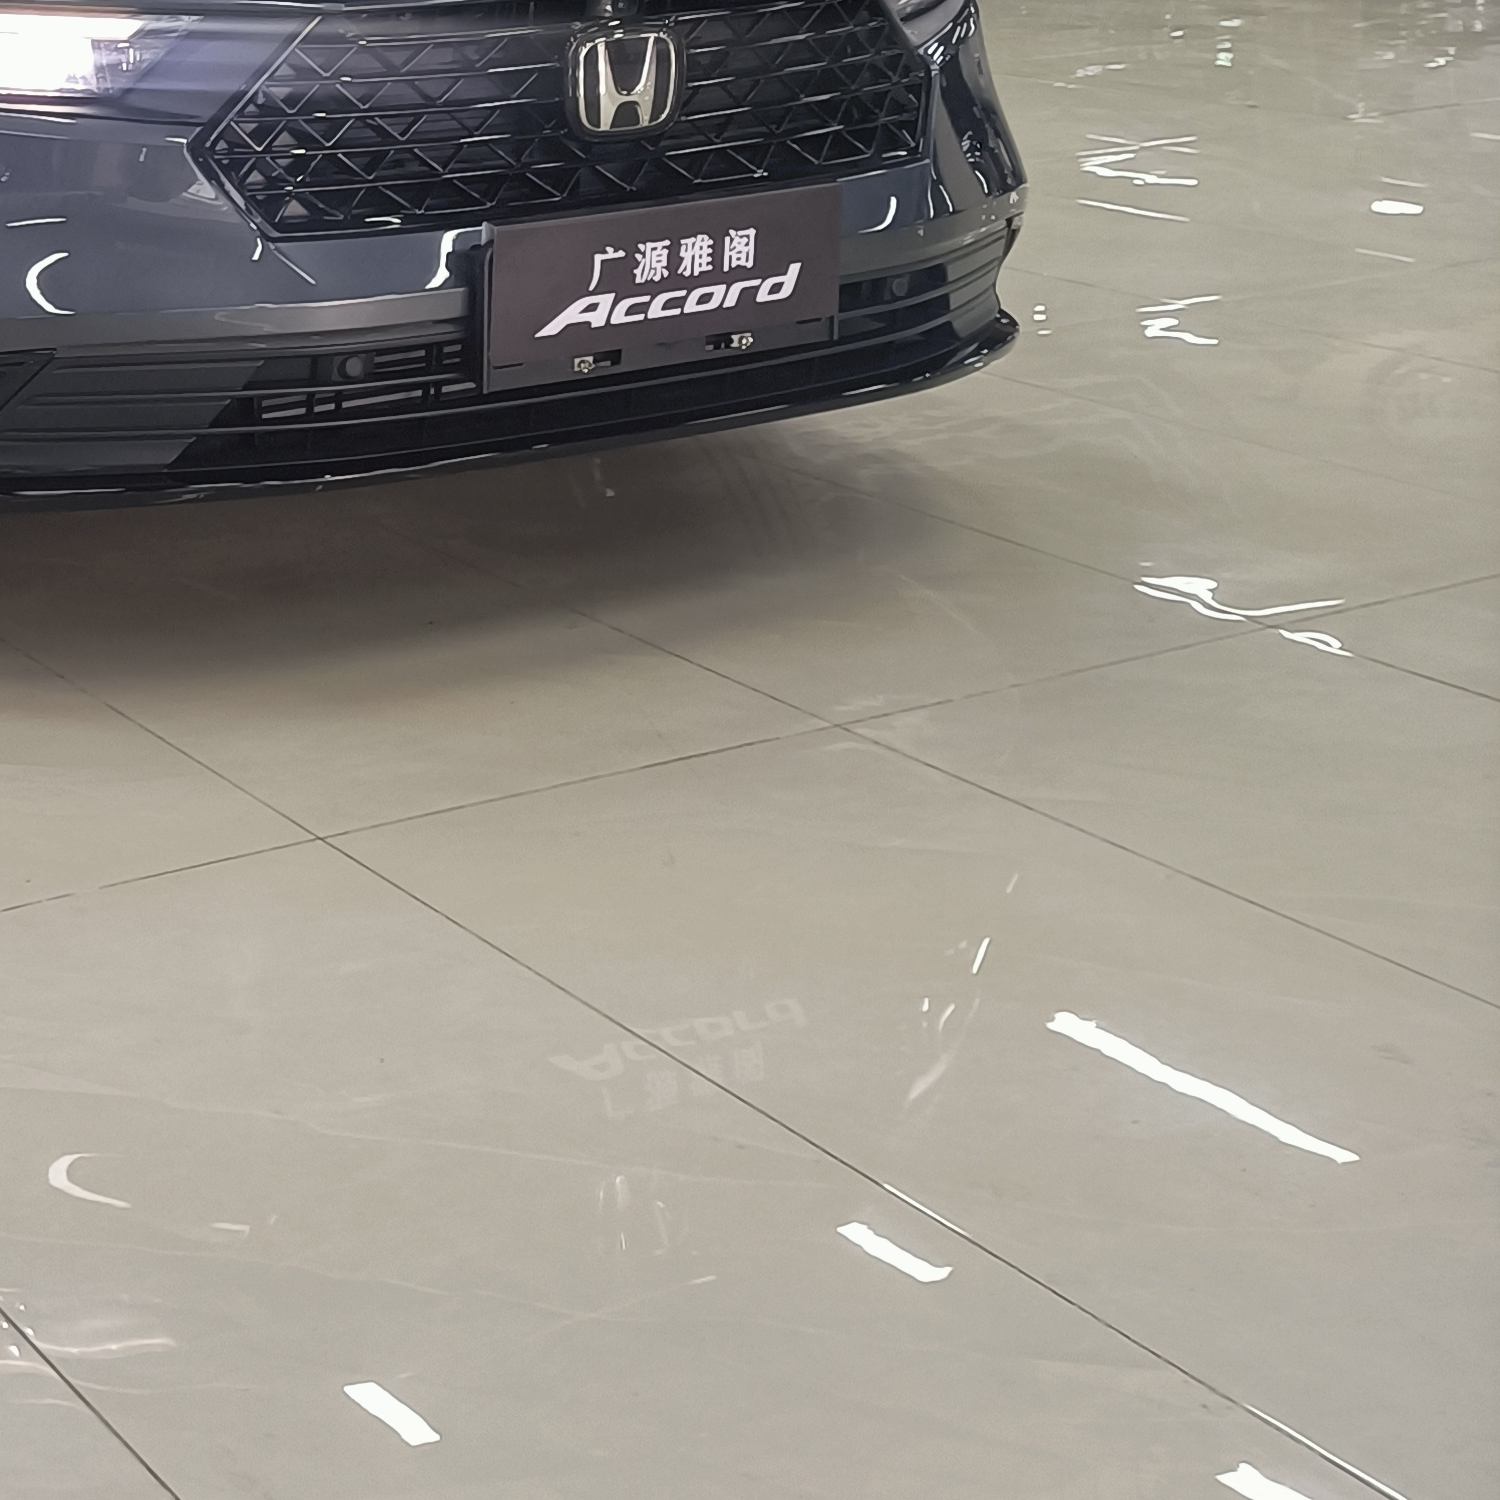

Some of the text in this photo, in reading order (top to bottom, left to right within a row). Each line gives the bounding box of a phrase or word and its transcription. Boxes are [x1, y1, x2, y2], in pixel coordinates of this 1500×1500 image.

[587, 227, 758, 292] 广源雅阁
[533, 262, 803, 340] Accord
